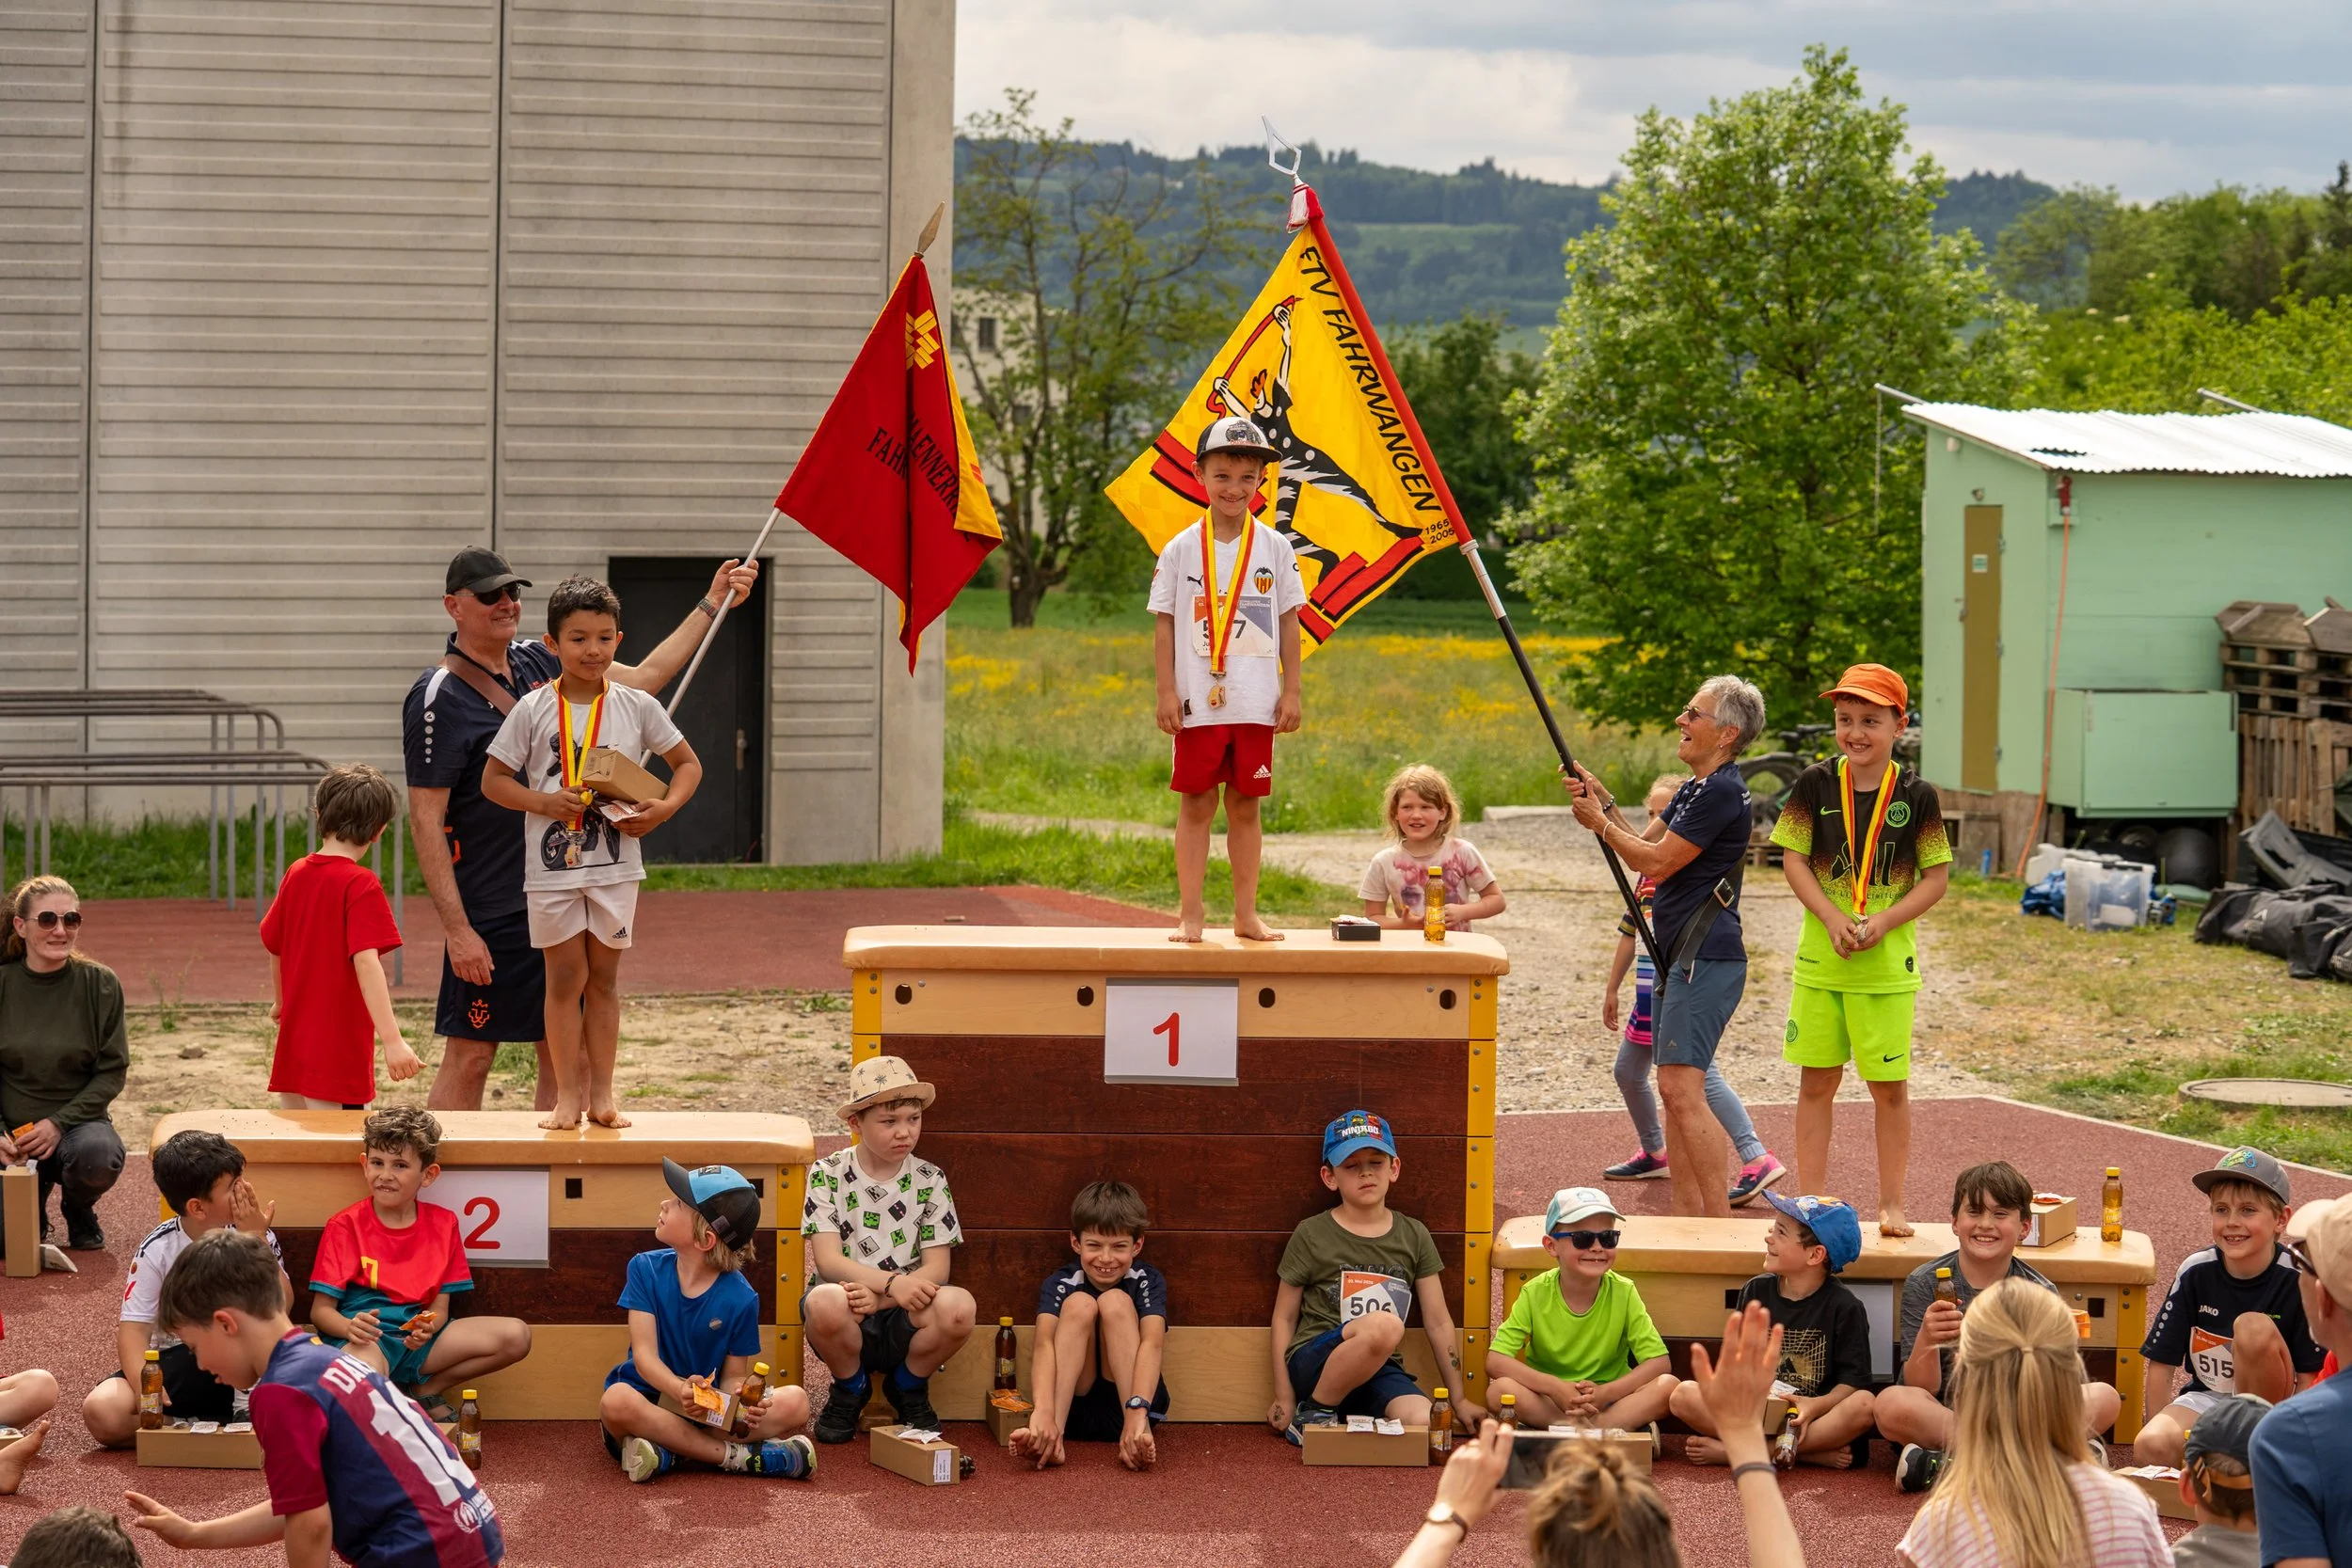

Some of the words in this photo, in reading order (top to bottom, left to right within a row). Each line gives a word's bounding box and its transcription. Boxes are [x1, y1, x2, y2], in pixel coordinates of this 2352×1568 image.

[1322, 309, 1442, 512] FAHRWANGEN
[1425, 518, 1450, 535] 1965
[1429, 527, 1455, 544] 2005
[1152, 1011, 1180, 1068] 1
[1342, 1125, 1379, 1137] NINJAGO
[463, 1196, 501, 1250] 2
[360, 1256, 379, 1290] 7
[2199, 1305, 2219, 1317] JAKO
[2199, 1354, 2233, 1379] 515
